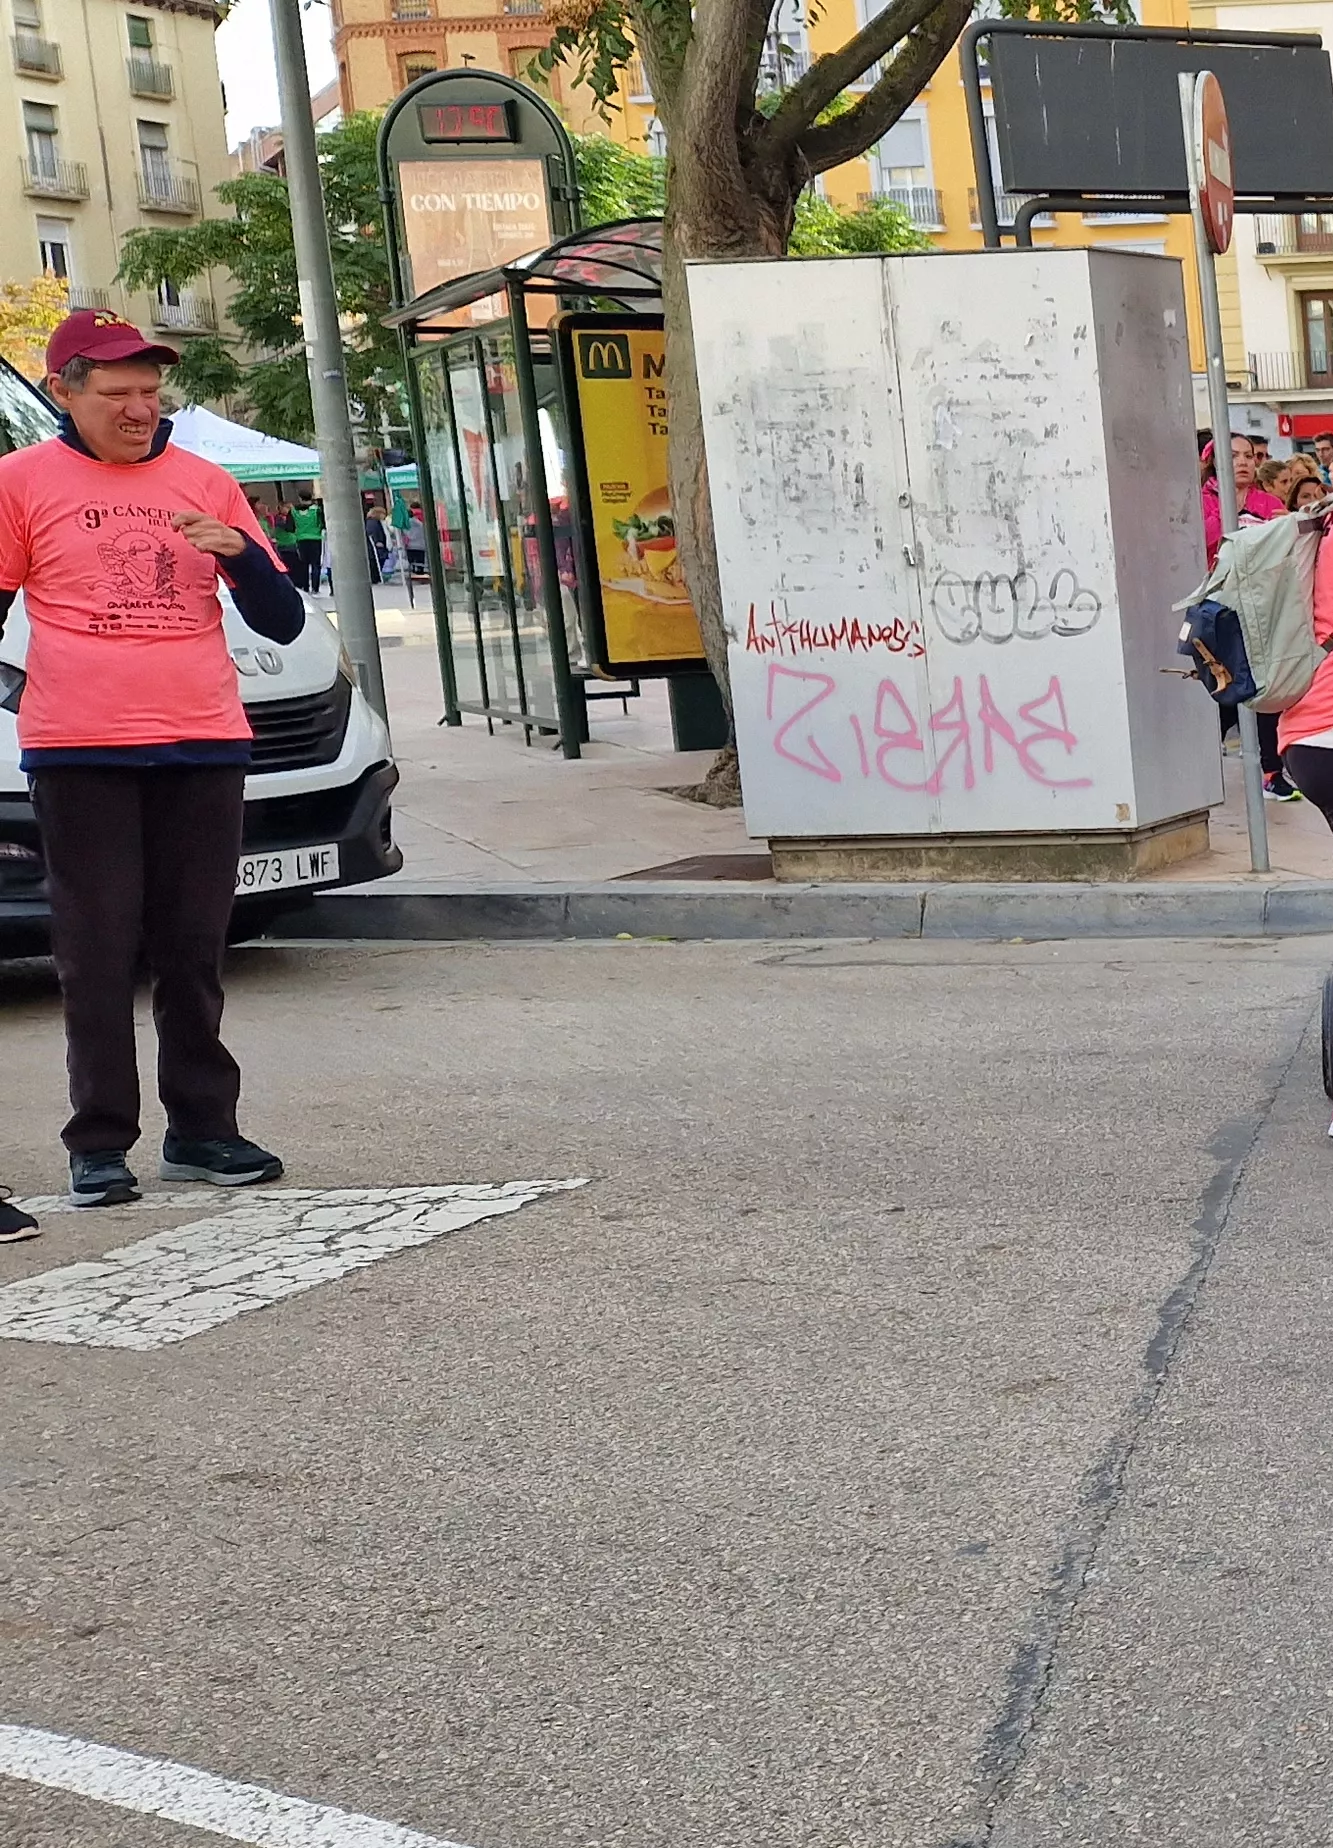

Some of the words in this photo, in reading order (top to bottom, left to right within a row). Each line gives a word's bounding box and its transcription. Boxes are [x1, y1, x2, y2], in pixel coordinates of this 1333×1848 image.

[411, 193, 457, 212] CON
[462, 193, 540, 212] TIEMPO
[296, 851, 330, 881] LWF
